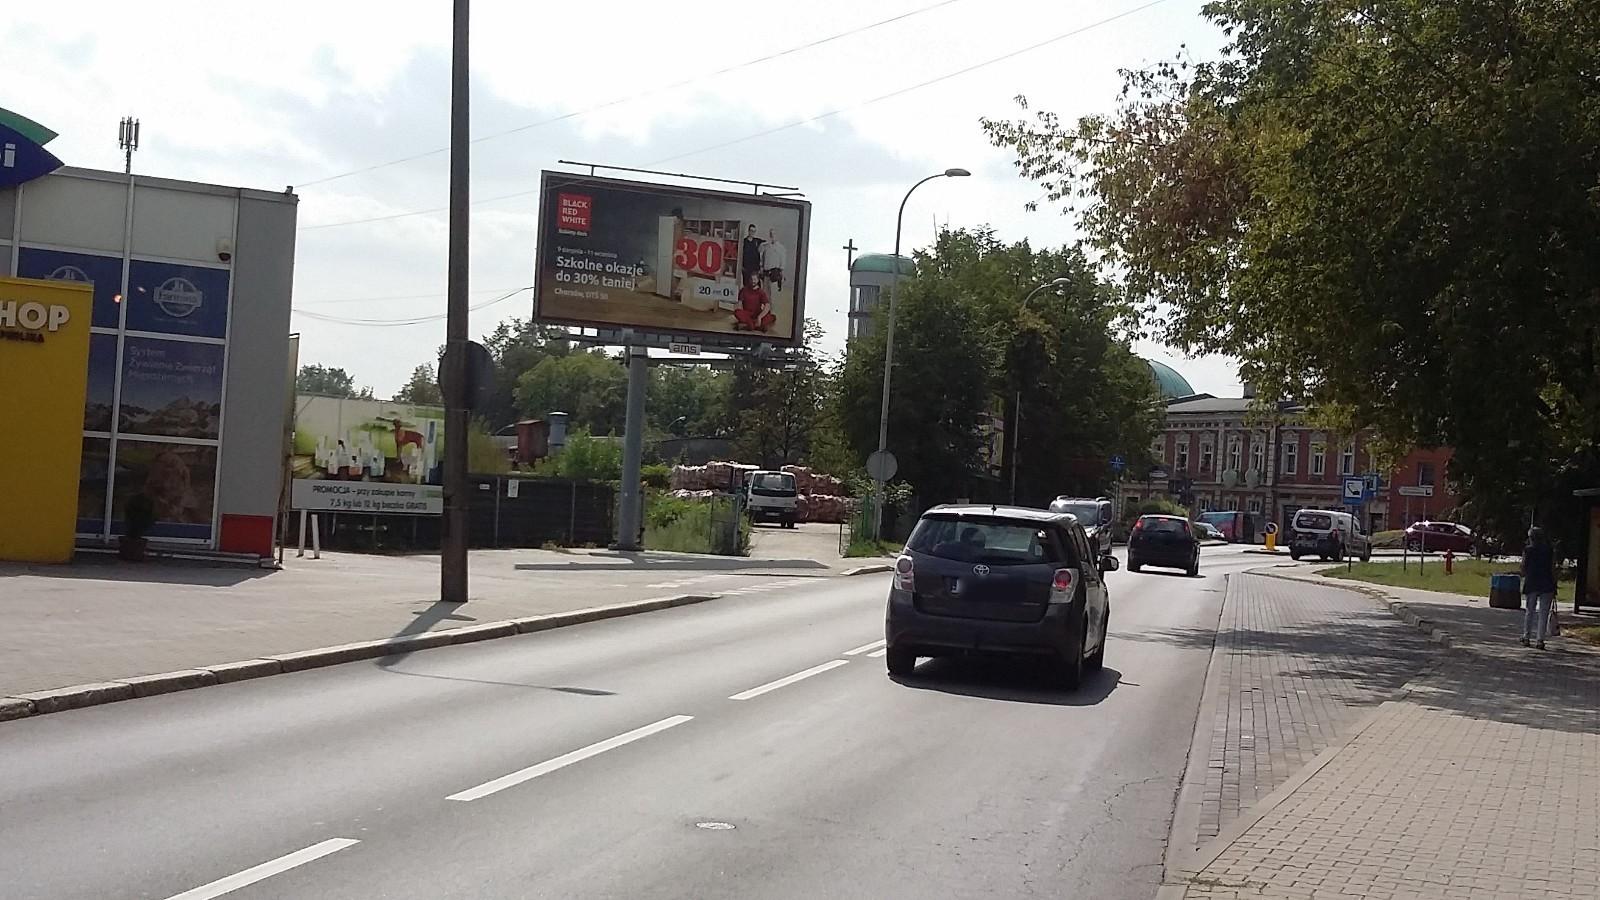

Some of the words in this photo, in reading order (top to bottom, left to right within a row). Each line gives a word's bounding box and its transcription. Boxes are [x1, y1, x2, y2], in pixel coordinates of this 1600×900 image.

[562, 199, 588, 208] BLACK
[561, 216, 587, 225] WHITE
[556, 256, 603, 272] Szkolne
[605, 262, 644, 277] okazje
[556, 270, 571, 282] do
[573, 273, 600, 285] 30%
[602, 276, 636, 291] taniej
[698, 286, 711, 295] 20
[673, 344, 697, 354] ams
[312, 485, 351, 495] PROMOCJA
[357, 489, 370, 497] przy
